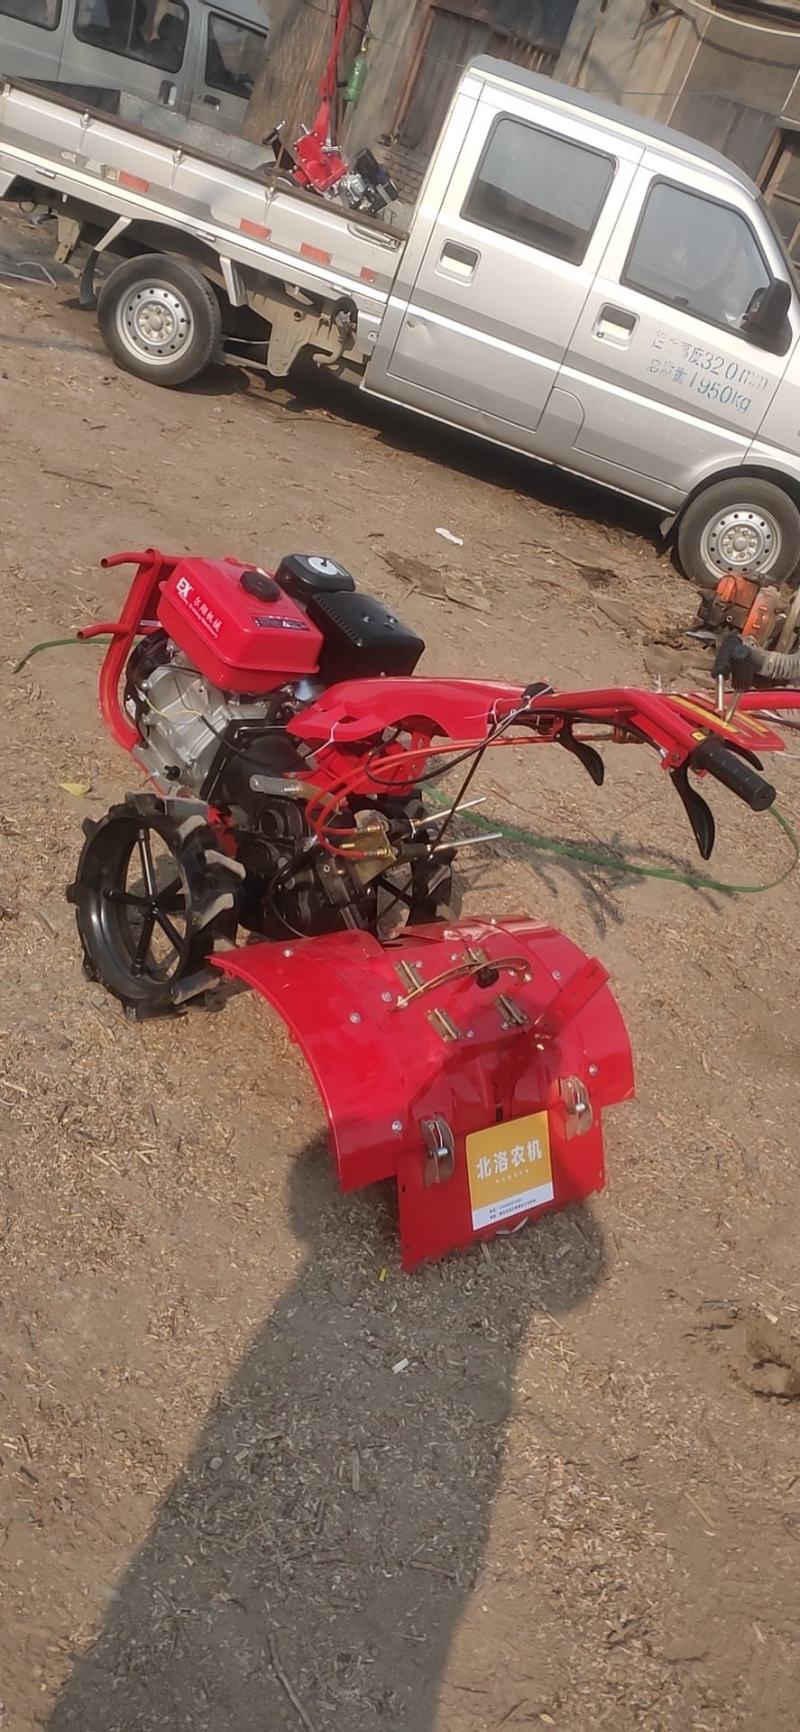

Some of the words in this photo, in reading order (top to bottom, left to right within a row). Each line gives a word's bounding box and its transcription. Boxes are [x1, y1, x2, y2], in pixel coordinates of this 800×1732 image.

[176, 576, 192, 599] EX
[476, 1139, 542, 1180] 北洛农机
